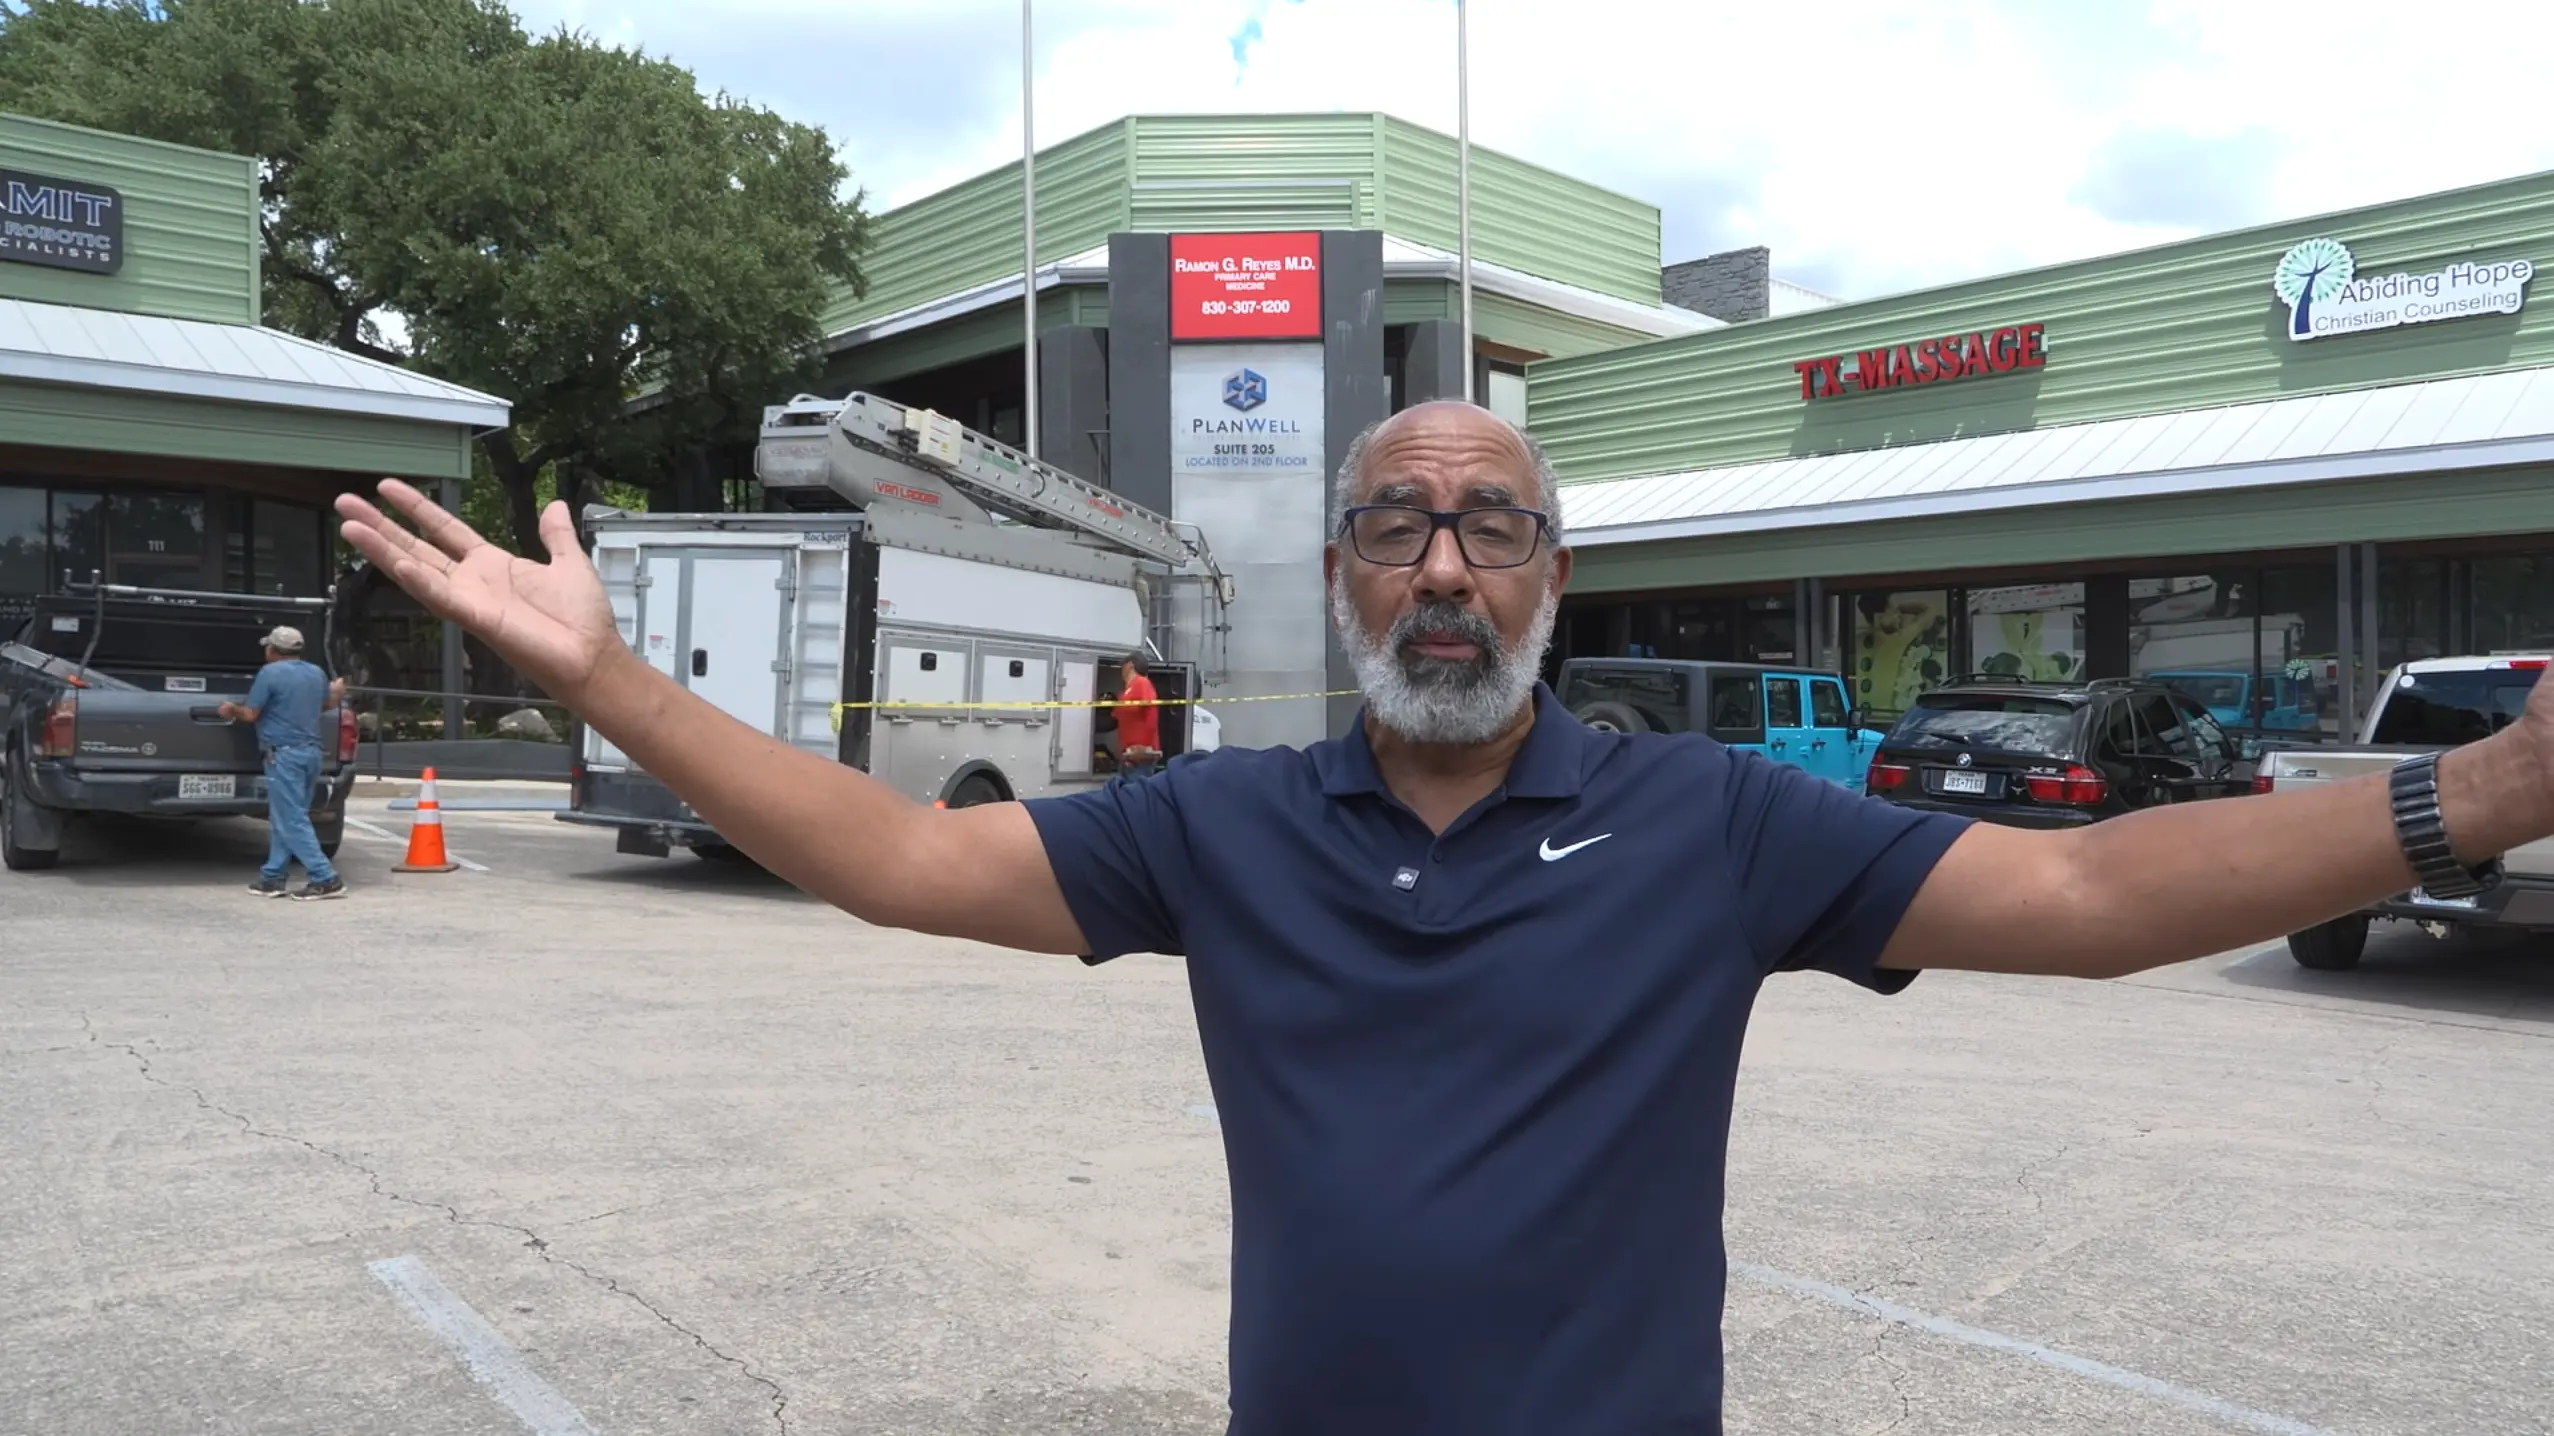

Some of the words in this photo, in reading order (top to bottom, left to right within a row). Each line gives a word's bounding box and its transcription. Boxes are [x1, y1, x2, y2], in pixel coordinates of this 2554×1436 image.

[4, 221, 111, 249] ROBOTIC
[1175, 259, 1219, 272] RAMON
[1222, 258, 1238, 272] G.
[1242, 257, 1281, 271] REYES
[1285, 256, 1315, 271] M.D.
[1214, 272, 1251, 281] PRIMARY
[1253, 272, 1276, 281] CARE
[2338, 271, 2439, 305] Abiding
[2451, 260, 2528, 288] Hope
[1226, 282, 1264, 290] MEDICINE
[1202, 300, 1290, 314] 830-307-1200
[2315, 308, 2397, 332] Christian
[2404, 290, 2518, 319] Counseling
[1794, 323, 2046, 400] TX-MASSAGE
[1214, 444, 1247, 455] SUITE
[1252, 444, 1275, 455] 205
[1186, 457, 1228, 467] LOCATED
[1232, 457, 1249, 466] ON
[1252, 457, 1272, 466] 2ND
[1276, 456, 1307, 466] FLOOR
[804, 532, 847, 543] Rockport
[148, 540, 165, 551] 111
